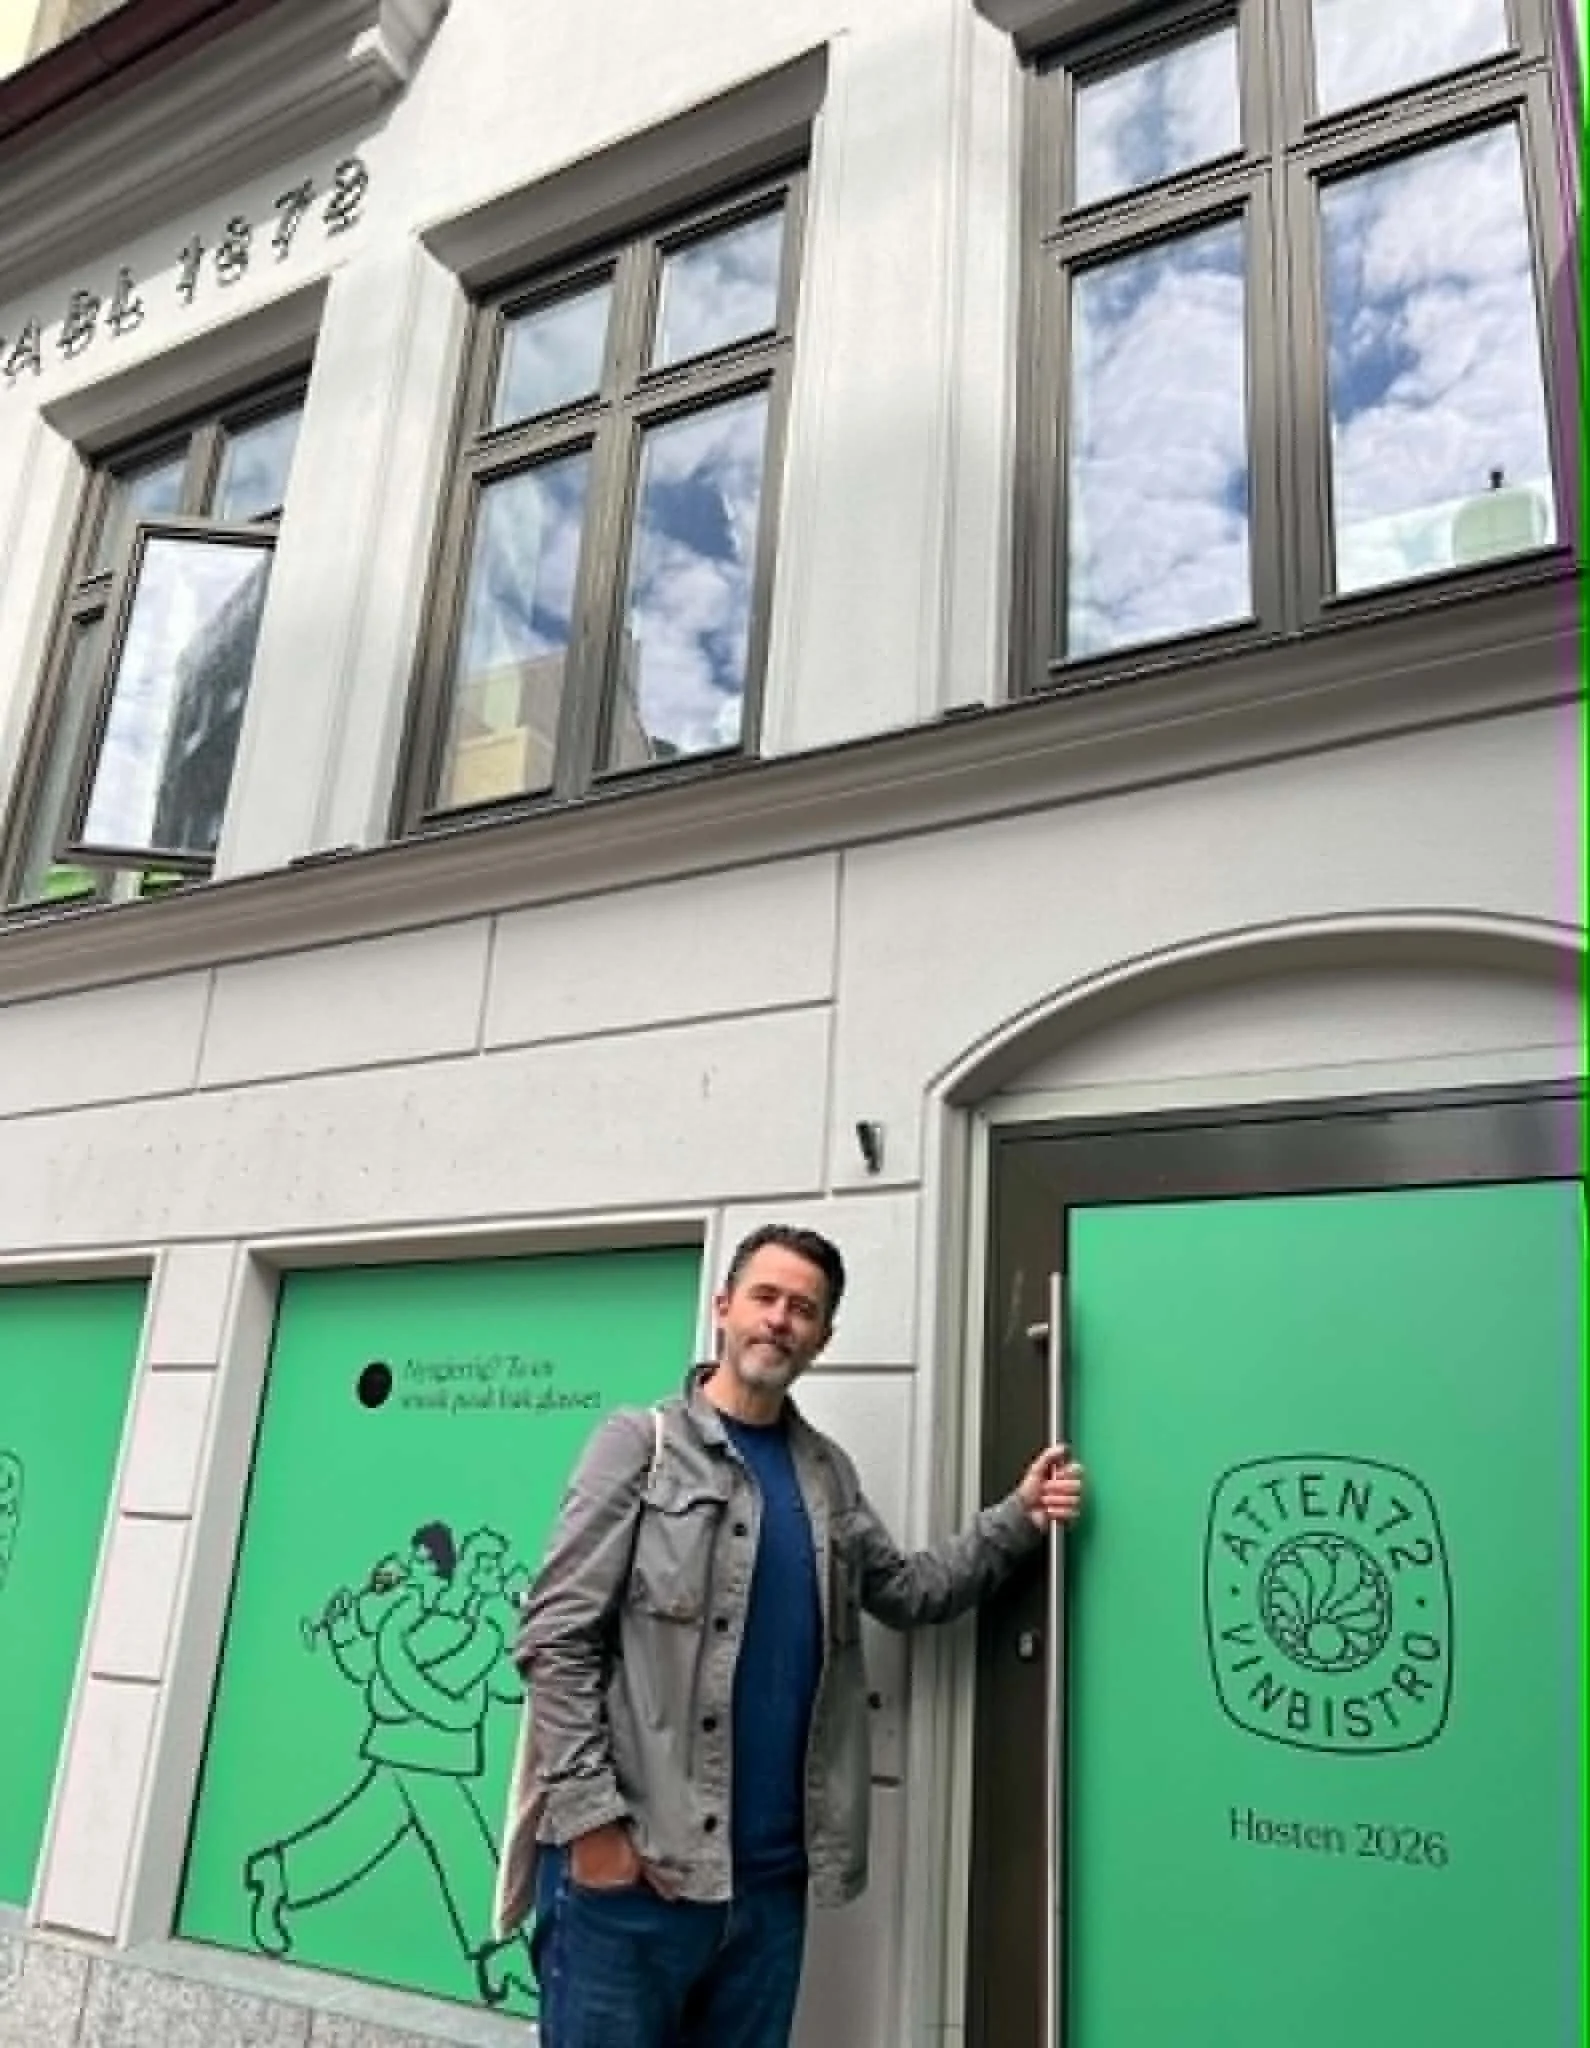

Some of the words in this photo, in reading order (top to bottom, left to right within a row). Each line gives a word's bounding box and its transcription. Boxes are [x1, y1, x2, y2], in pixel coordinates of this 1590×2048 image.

[0, 264, 144, 384] ABL
[1221, 1623, 1440, 1737] VINBISTRO
[1230, 1807, 1346, 1853] Høsten
[1355, 1824, 1449, 1868] 2026
